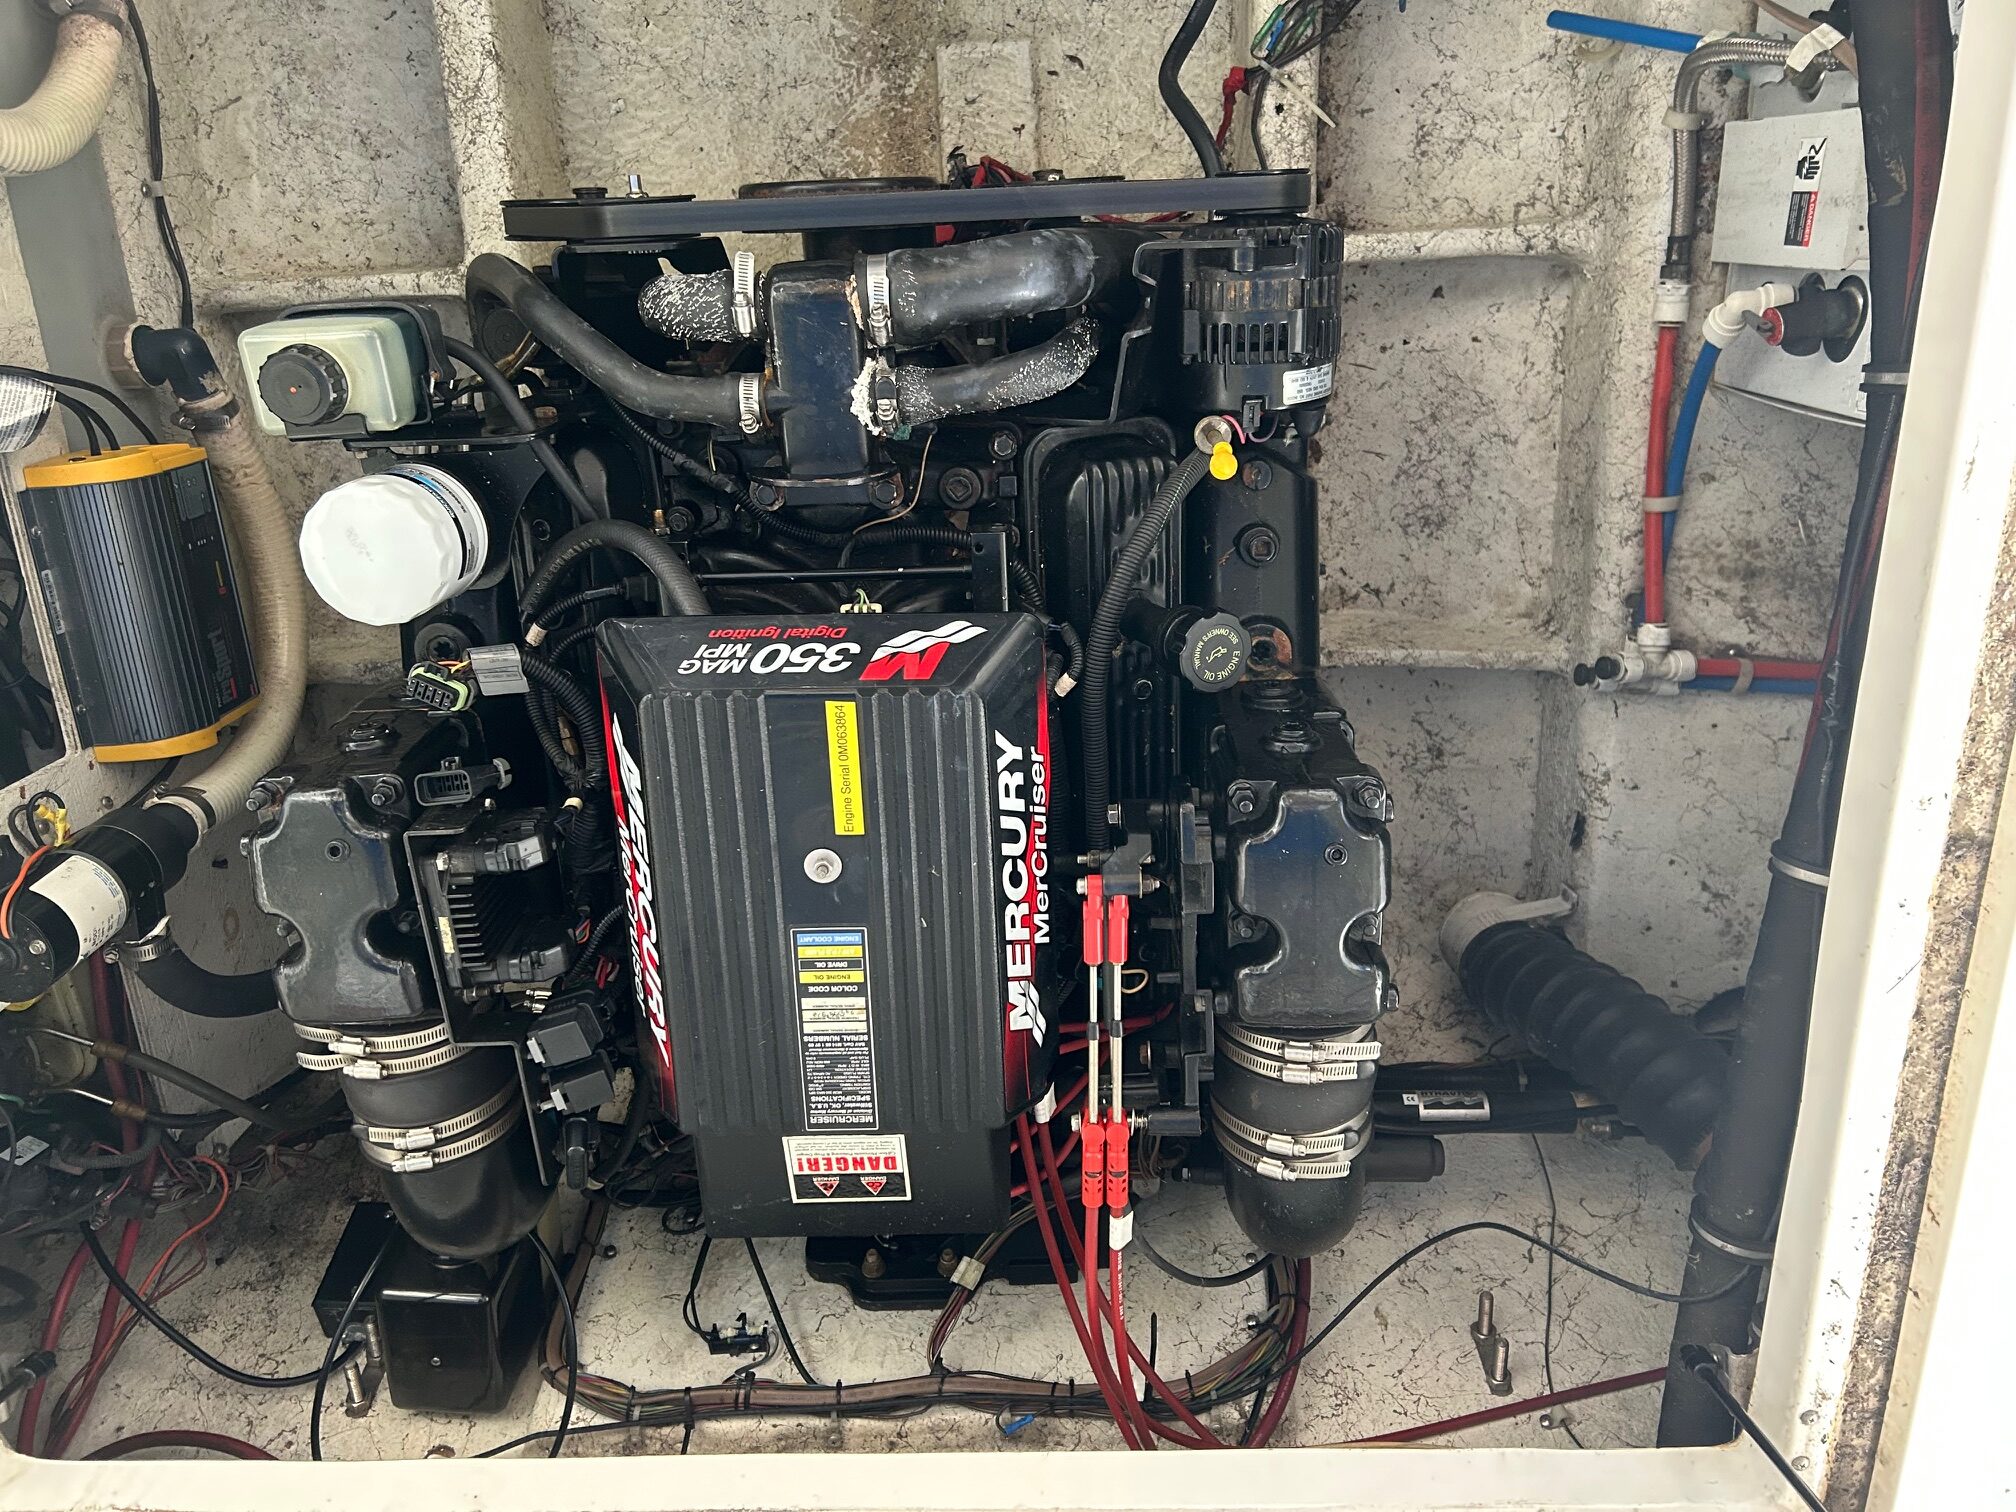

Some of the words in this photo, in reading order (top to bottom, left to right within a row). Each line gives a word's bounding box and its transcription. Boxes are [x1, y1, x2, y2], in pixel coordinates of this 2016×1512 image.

[1804, 204, 1814, 242] DANGER
[708, 627, 777, 640] Ignition
[780, 625, 847, 639] Digital
[1229, 632, 1238, 644] SEE
[693, 643, 752, 659] MPI
[748, 643, 861, 673] 350
[1194, 640, 1204, 669] MANUAL
[1218, 651, 1240, 680] ENGINE
[678, 659, 746, 675] MAG
[1204, 670, 1214, 680] OIL
[841, 765, 851, 794] Serial
[844, 797, 854, 832] Engine
[1030, 746, 1050, 944] MerCruiser
[614, 714, 670, 1067] MERCURY
[995, 730, 1042, 1043] MERCURY
[616, 815, 647, 1018] MerCruiser
[796, 1156, 897, 1172] DANGER!
